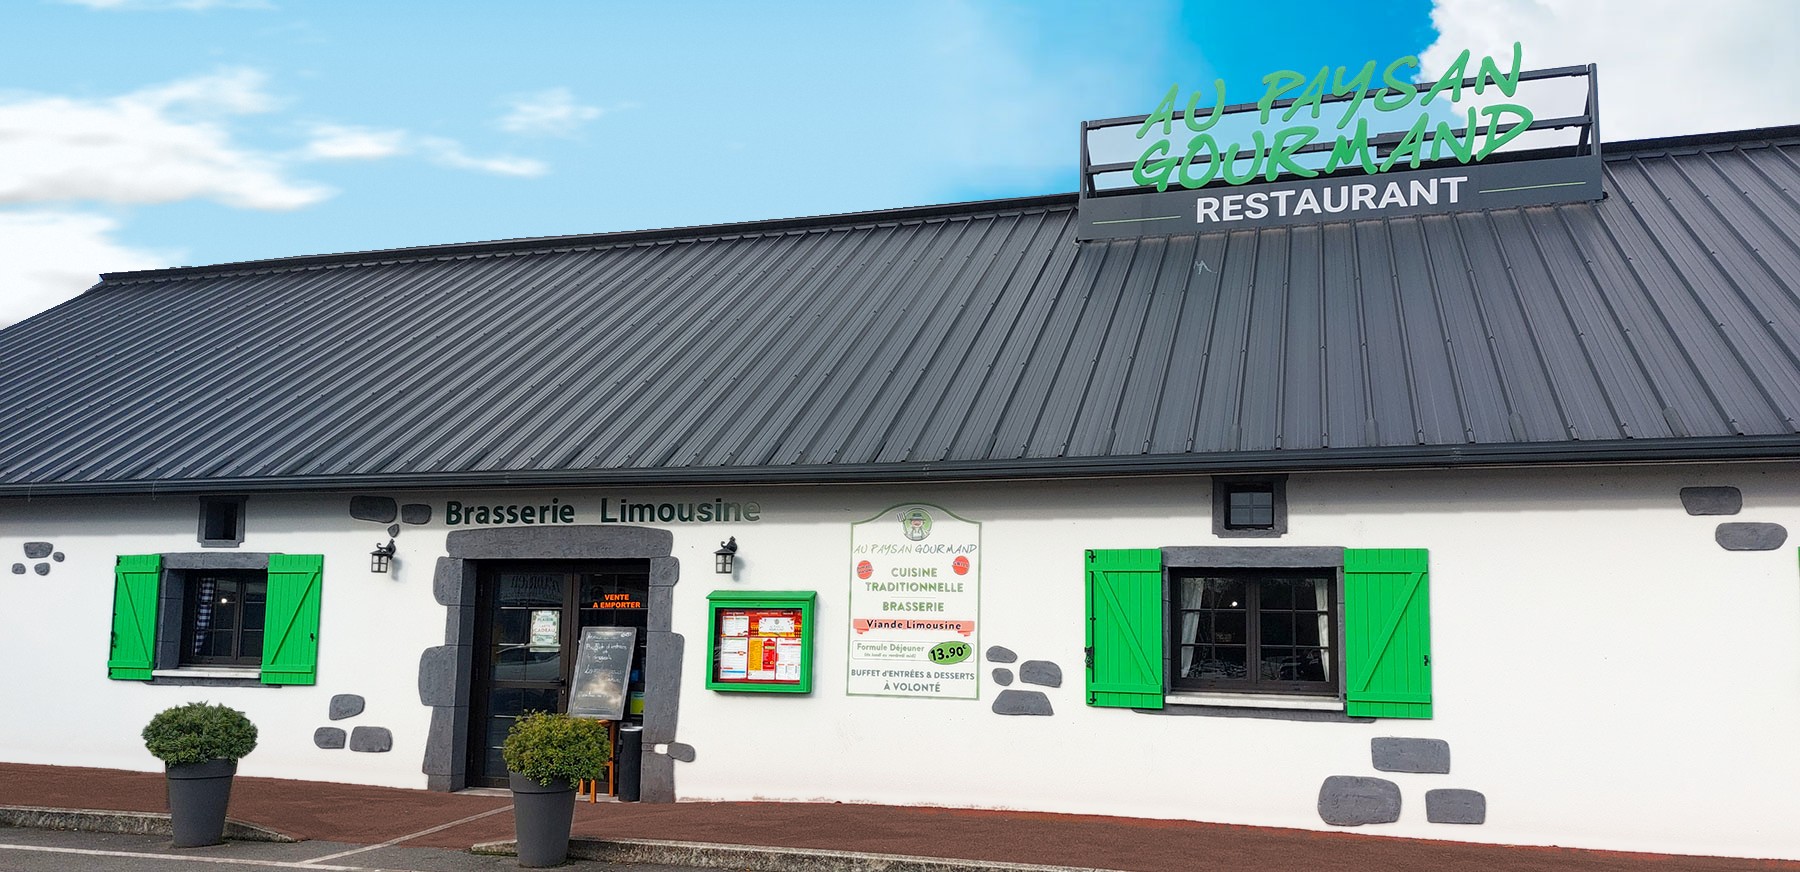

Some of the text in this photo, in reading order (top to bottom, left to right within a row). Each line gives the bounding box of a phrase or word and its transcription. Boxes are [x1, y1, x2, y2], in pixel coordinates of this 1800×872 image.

[1136, 41, 1522, 139] AU PAYSAN
[1132, 104, 1534, 192] GOURMAND
[1196, 176, 1468, 223] RESTAURANT
[445, 498, 761, 525] Brasserie Limousine
[854, 543, 978, 555] AU PAYSAN GOURMAND
[891, 567, 938, 578] CUISINE
[865, 581, 964, 593] TRADITIONNELLE
[600, 601, 641, 609] EMPORTER
[882, 601, 945, 612] BRASSERIE
[866, 619, 961, 630] Viande Limousine
[857, 643, 925, 653] Formule Déjeuner
[851, 669, 880, 677] BUFFET
[882, 669, 924, 679] d'ENTRÉES
[934, 672, 976, 680] DESSERTS
[884, 680, 941, 692] À VOLONTÉ
